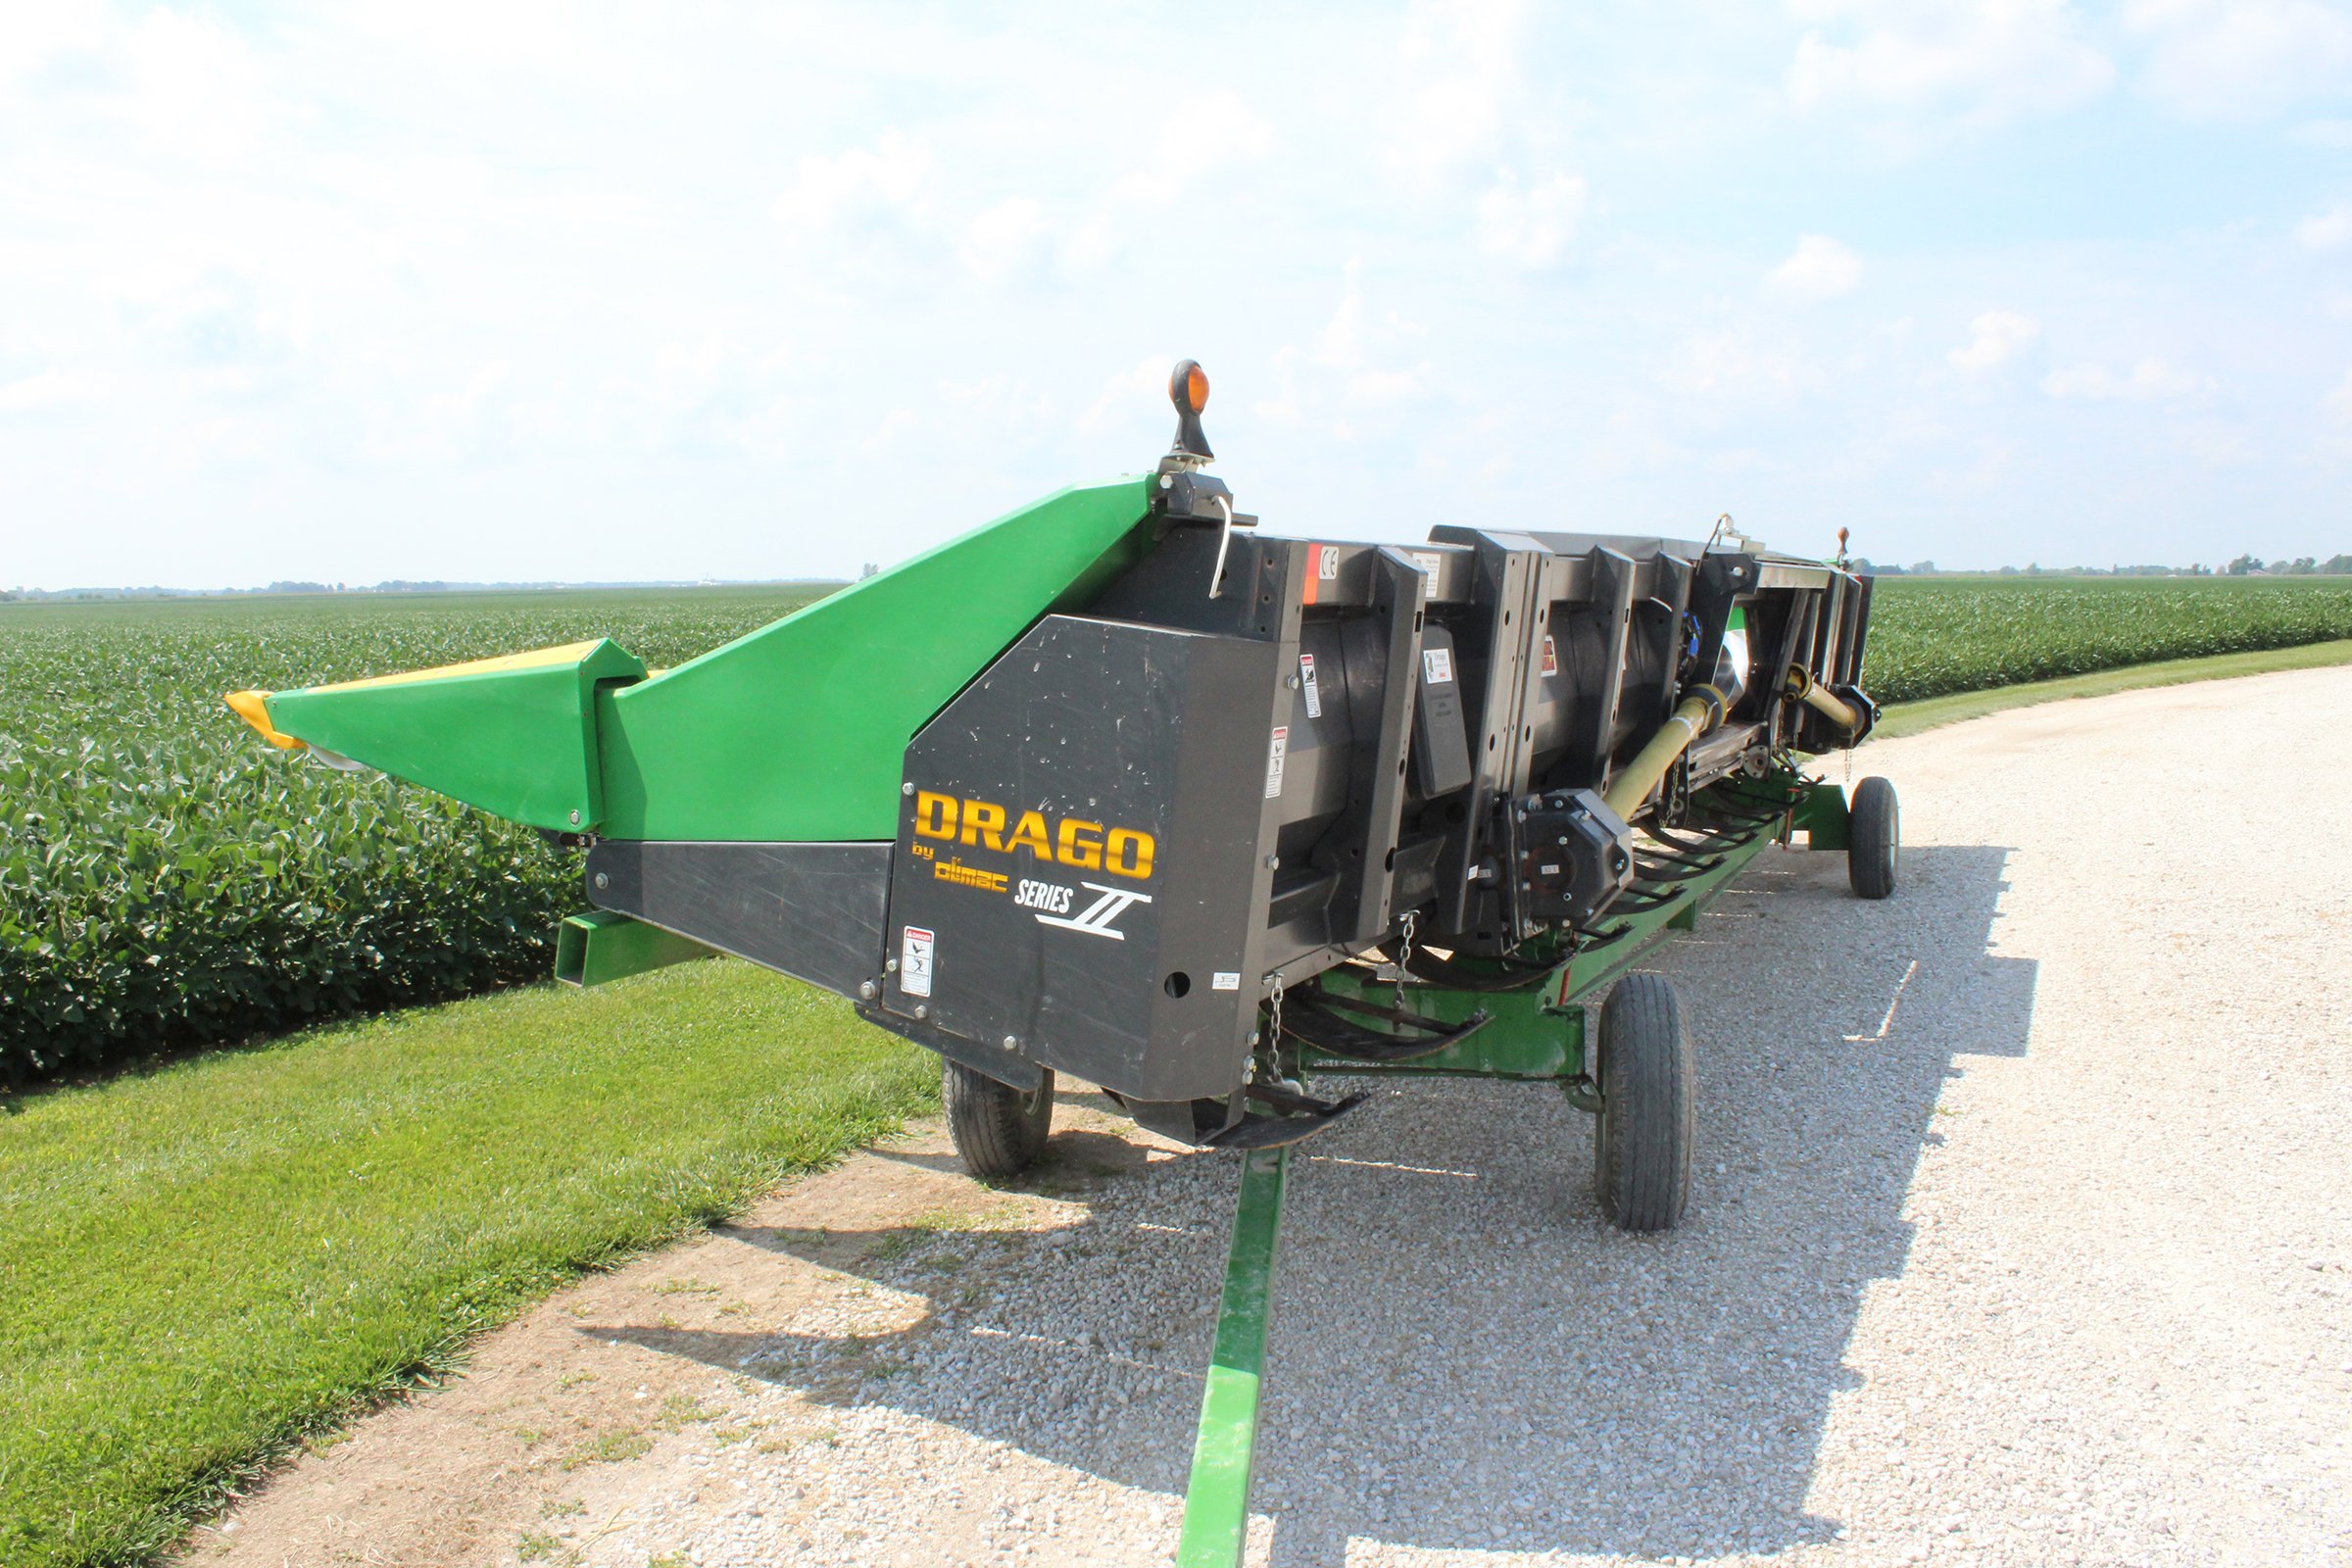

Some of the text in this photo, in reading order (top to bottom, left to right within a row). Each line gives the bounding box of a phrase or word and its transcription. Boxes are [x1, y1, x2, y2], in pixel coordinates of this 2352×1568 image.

[911, 841, 935, 861] by
[914, 789, 1156, 881] DRAGO
[1014, 878, 1074, 914] SERIES
